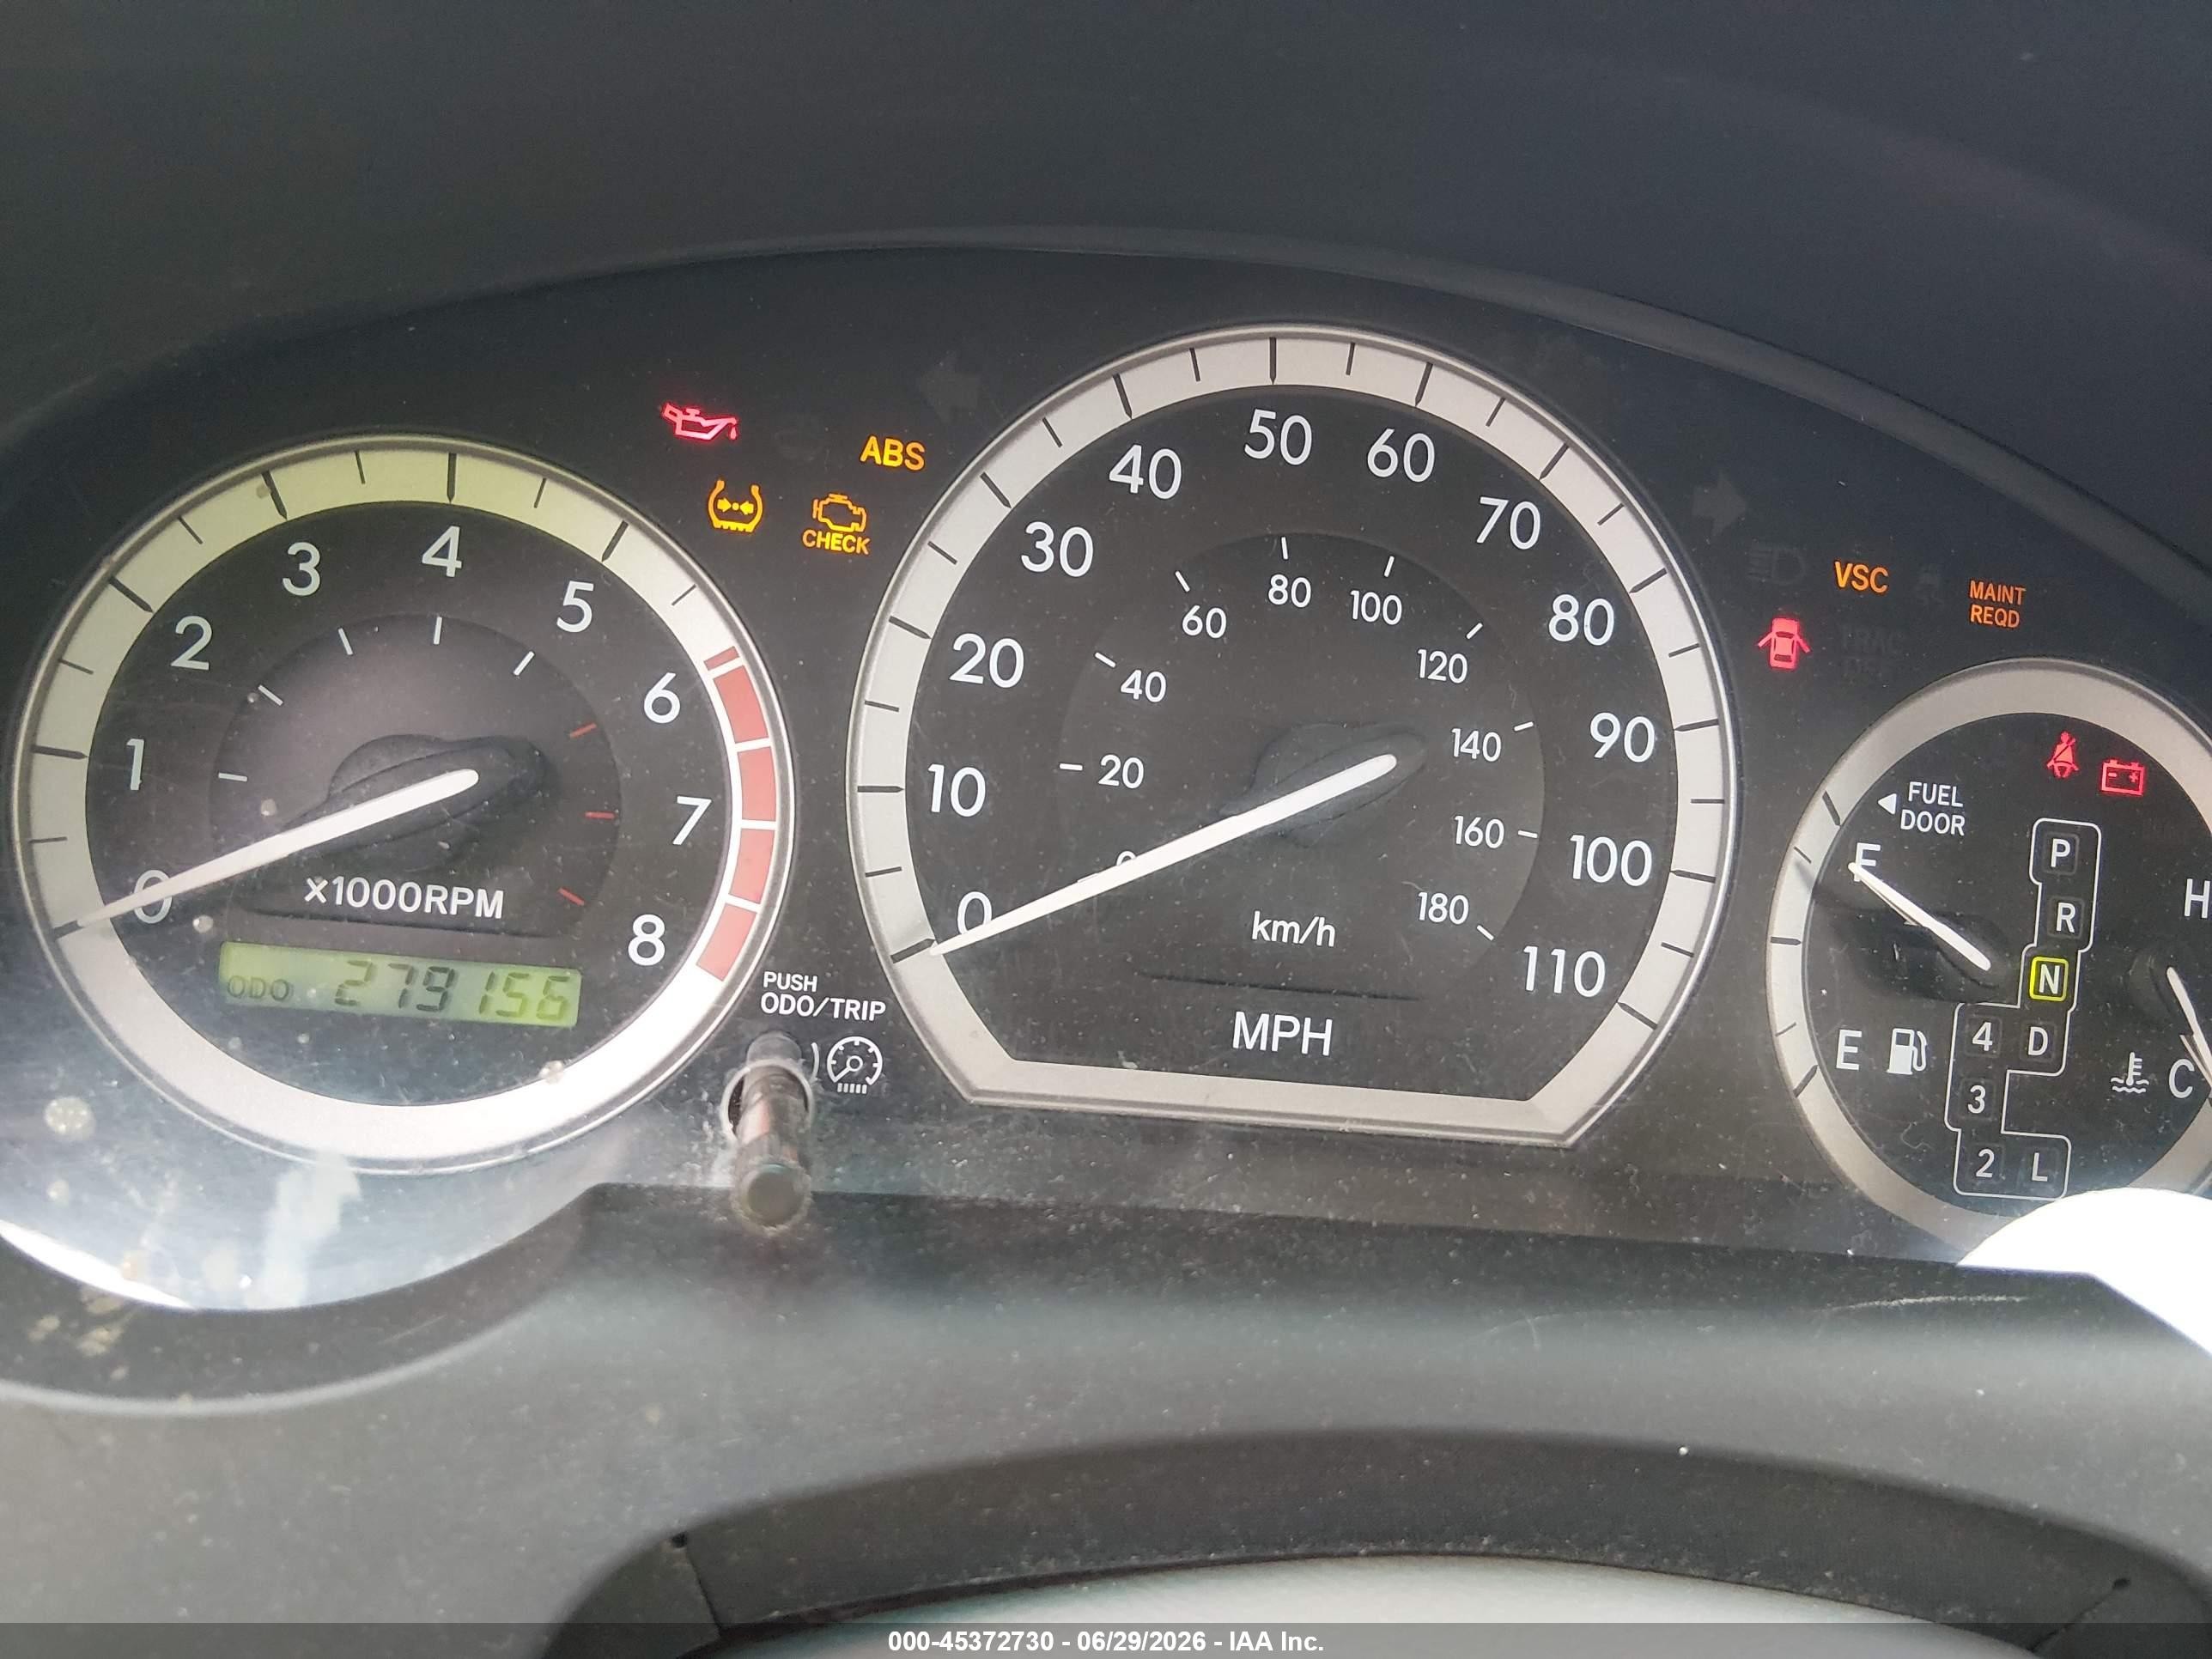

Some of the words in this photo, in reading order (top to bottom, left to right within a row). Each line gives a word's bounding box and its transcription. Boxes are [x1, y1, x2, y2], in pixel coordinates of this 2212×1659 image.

[860, 435, 925, 471] ABS
[1244, 409, 1312, 465] 50
[1367, 428, 1435, 483] 60
[1109, 444, 1182, 500] 40
[802, 528, 871, 555] CHECK
[1476, 496, 1540, 550] 70
[422, 526, 462, 578] 4
[1021, 521, 1094, 577] 30
[283, 542, 320, 596] 3
[1834, 561, 1888, 593] VSC
[556, 580, 594, 633] 5
[1267, 574, 1311, 608] 80
[1350, 590, 1402, 625] 100
[1969, 580, 2026, 605] MAINT
[1182, 605, 1227, 639] 60
[1548, 593, 1615, 646] 80
[1970, 604, 2020, 628] REQD
[170, 615, 212, 671] 2
[949, 633, 1024, 688] 20
[1120, 669, 1166, 702] 40
[1417, 648, 1468, 684] 120
[643, 672, 681, 724] 6
[1451, 728, 1502, 762] 140
[1589, 712, 1656, 763] 90
[126, 738, 145, 791] 1
[1097, 754, 1144, 789] 20
[927, 763, 986, 817] 10
[1908, 781, 1964, 807] FUEL
[672, 795, 712, 845] 7
[1455, 815, 1504, 849] 160
[1900, 809, 1966, 836] DOOR
[1570, 835, 1653, 887] 100
[1853, 842, 1881, 883] F
[2051, 838, 2071, 868] P
[133, 869, 173, 924] 0
[957, 890, 993, 936] 0
[1418, 891, 1469, 925] 180
[2184, 878, 2211, 919] H
[1252, 910, 1335, 947] km/h
[2056, 902, 2076, 933] R
[628, 914, 665, 966] 8
[225, 975, 292, 1005] ODO
[334, 959, 571, 1020] 279156
[763, 970, 817, 993] PUSH
[1523, 945, 1606, 998] 110
[2039, 963, 2061, 995] N
[761, 994, 886, 1022] ODO/TRIP
[1232, 1011, 1333, 1056] MPH
[1836, 1029, 1863, 1071] E
[1972, 1022, 1993, 1052] 4
[2027, 1026, 2049, 1056] D
[2168, 1058, 2195, 1099] C
[1967, 1085, 1986, 1114] 3
[1976, 1148, 1995, 1178] 2
[2032, 1152, 2048, 1182] L
